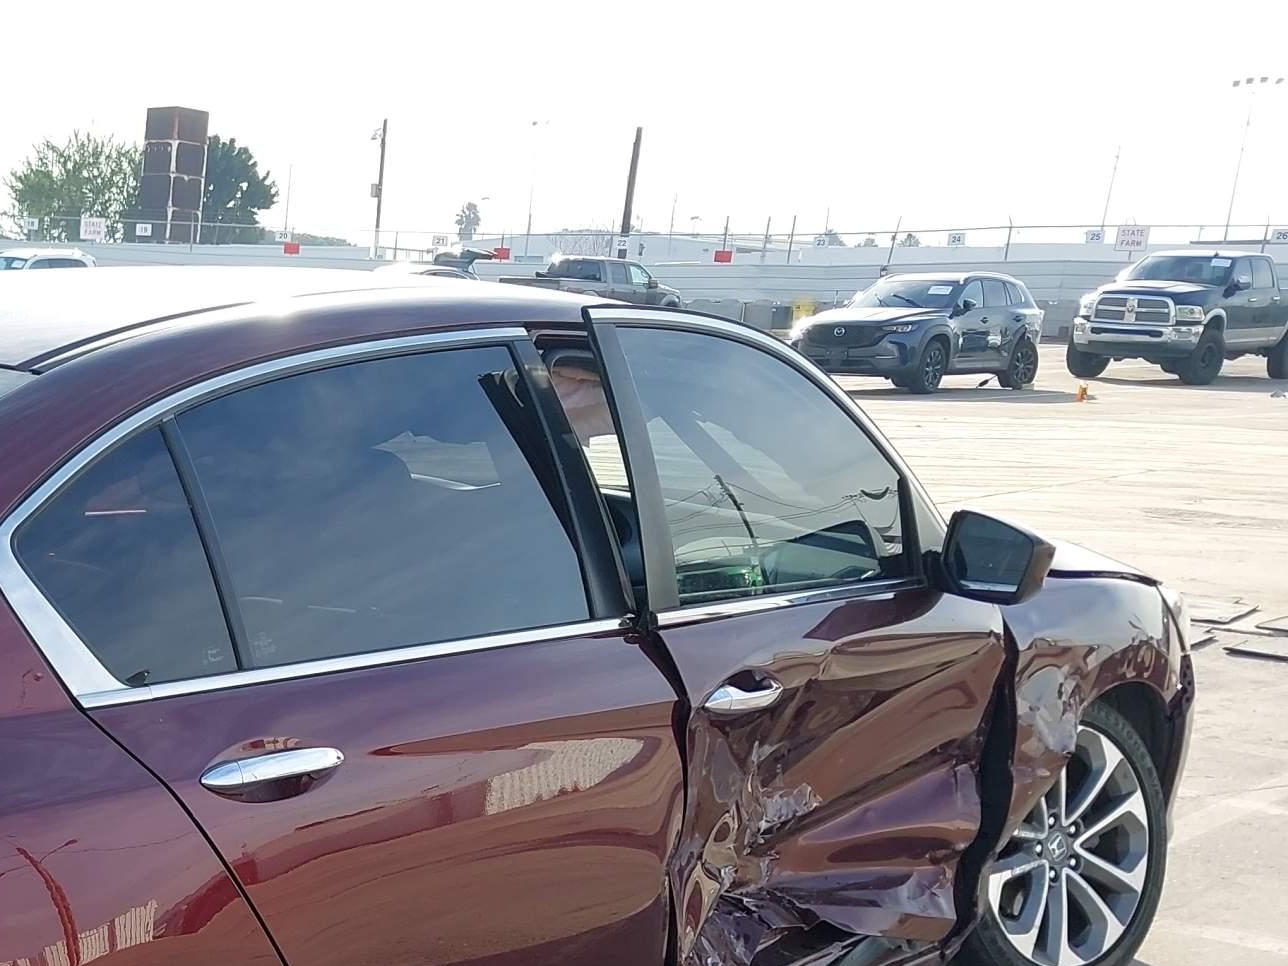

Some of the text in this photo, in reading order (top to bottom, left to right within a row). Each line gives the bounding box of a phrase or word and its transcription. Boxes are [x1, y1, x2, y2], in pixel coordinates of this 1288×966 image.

[1090, 233, 1101, 241] 25
[1120, 229, 1145, 237] STATE
[1276, 232, 1288, 240] 26
[617, 239, 627, 247] 22
[816, 239, 826, 247] 23
[951, 235, 961, 243] 24
[1120, 239, 1142, 247] FARM
